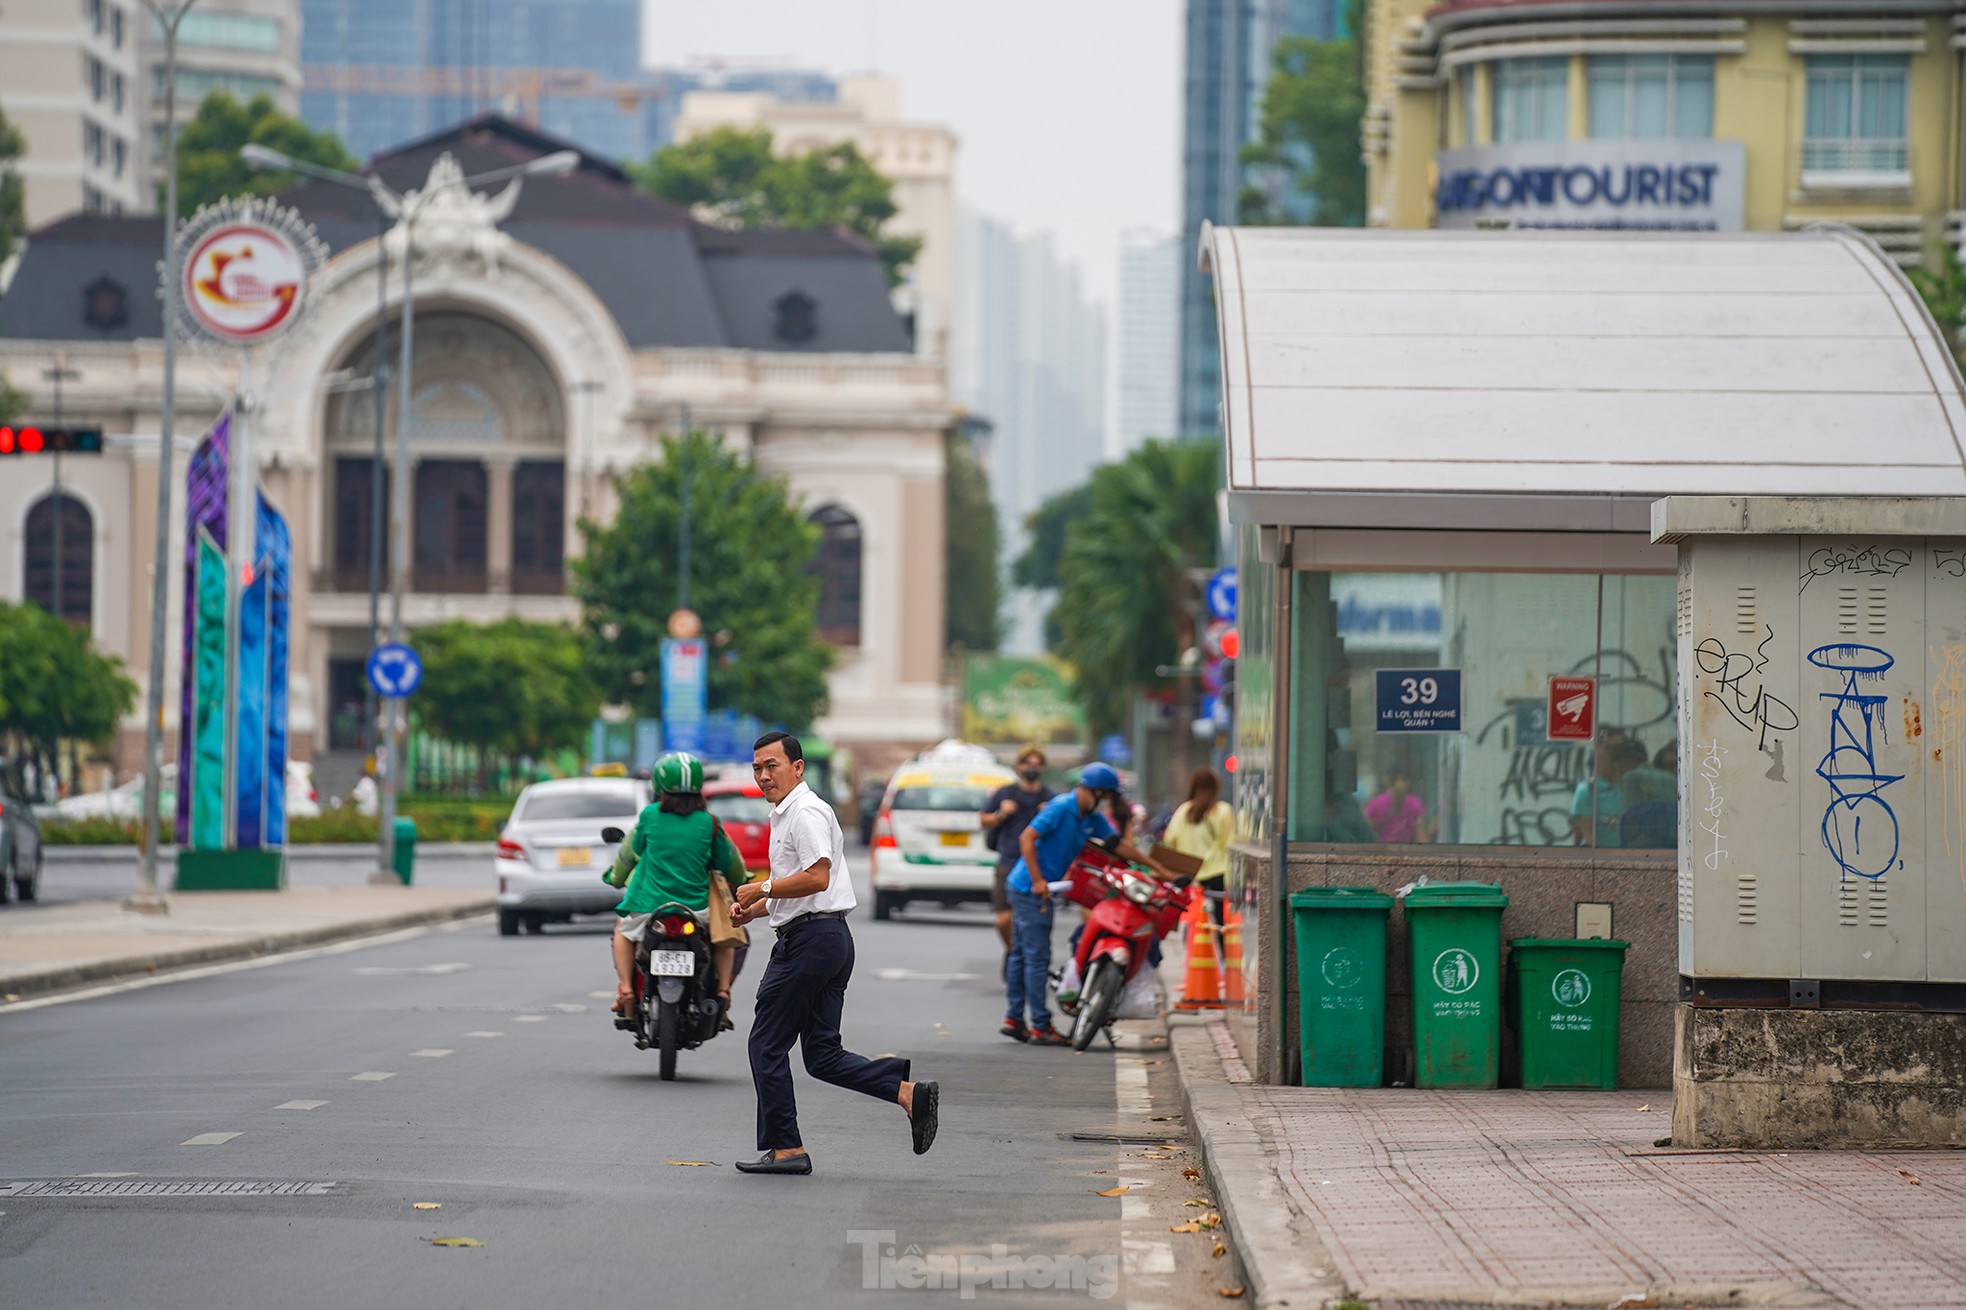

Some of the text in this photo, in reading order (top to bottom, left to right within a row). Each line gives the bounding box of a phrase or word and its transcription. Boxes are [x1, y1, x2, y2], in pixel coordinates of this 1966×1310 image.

[1400, 677, 1438, 704] 39
[1555, 682, 1589, 691] WARNING
[1430, 719, 1435, 727] 1
